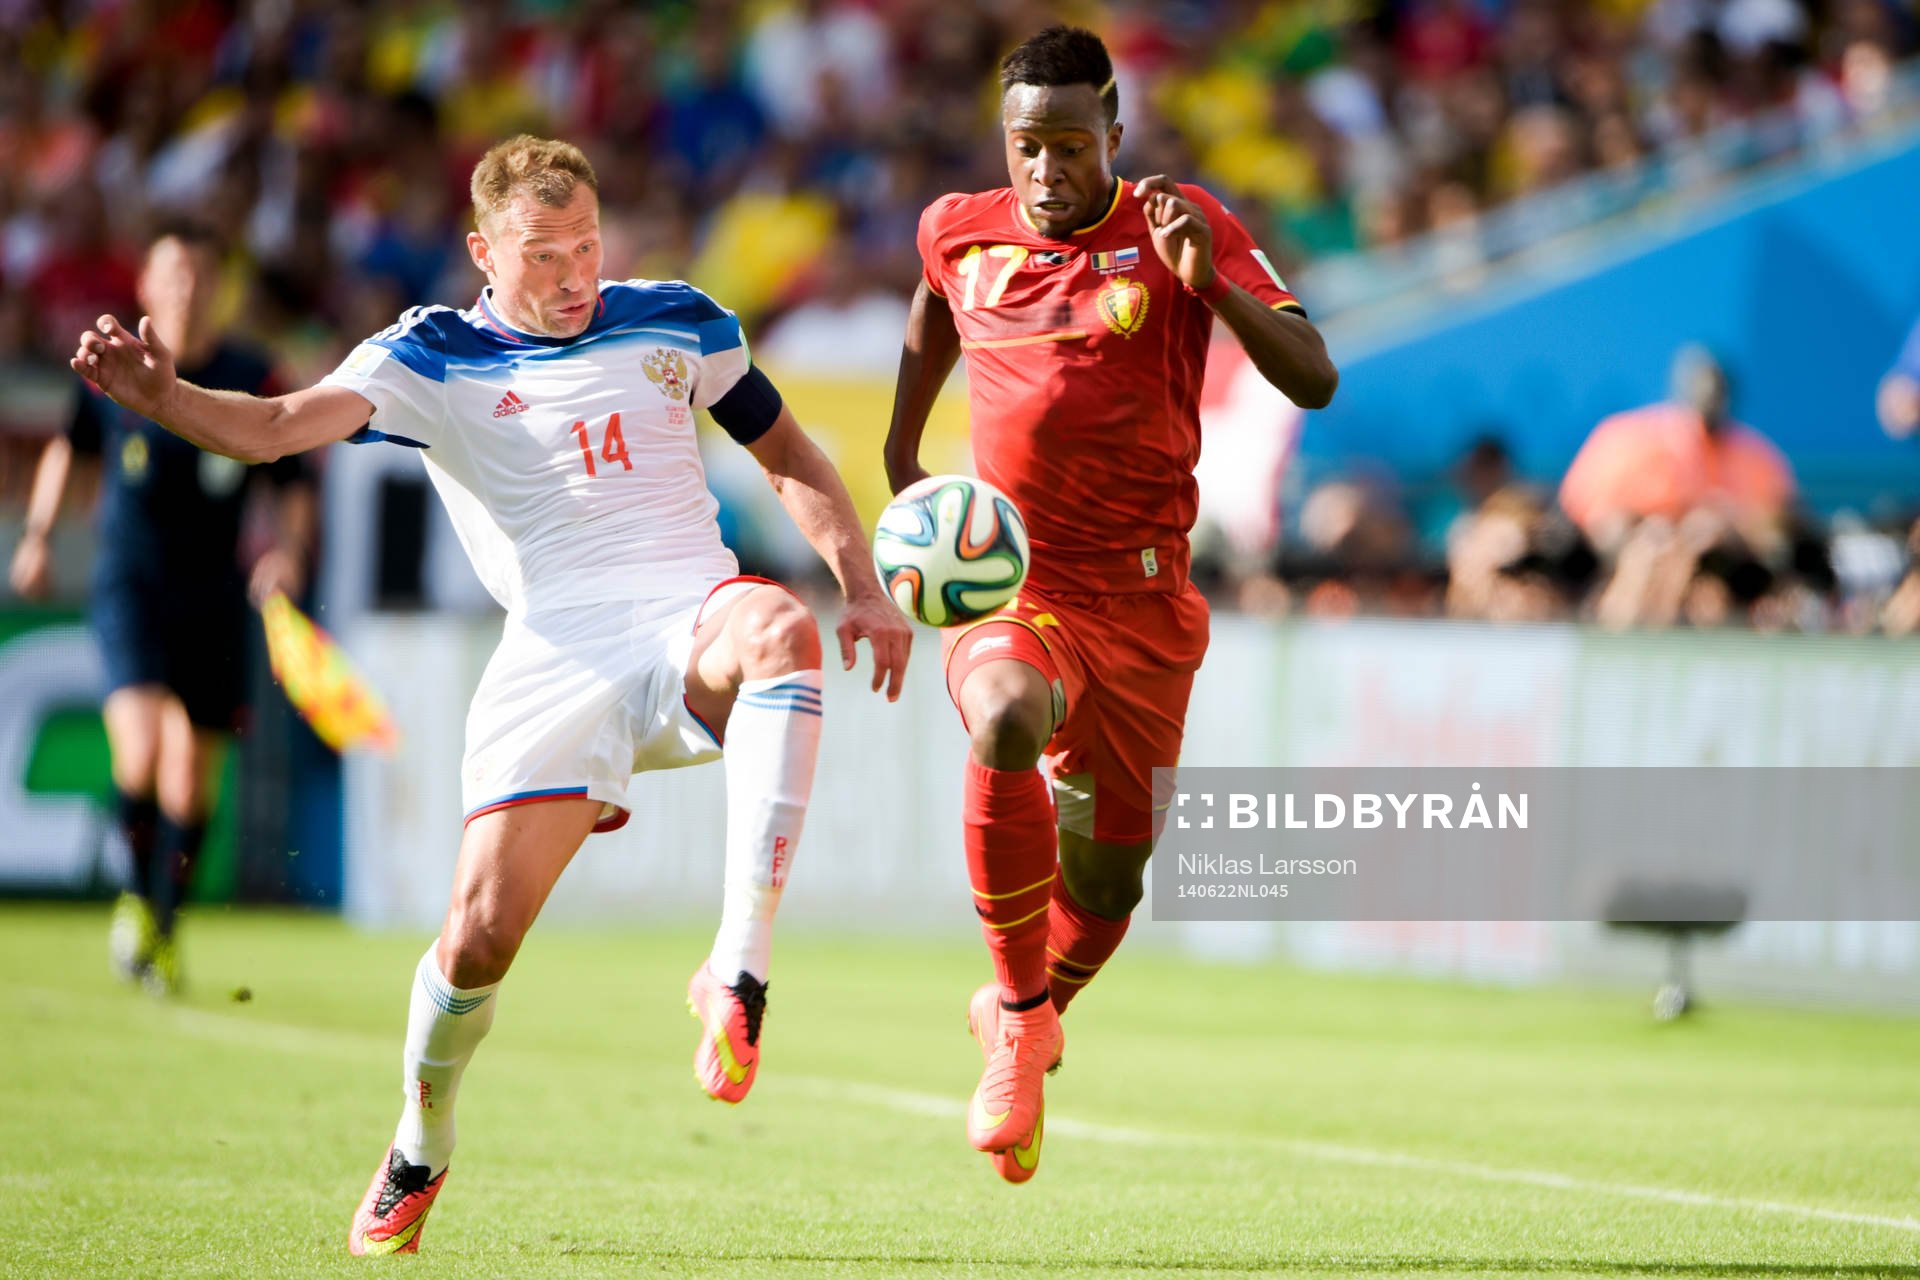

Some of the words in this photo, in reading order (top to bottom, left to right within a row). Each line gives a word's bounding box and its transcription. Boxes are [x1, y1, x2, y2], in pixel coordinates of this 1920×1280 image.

[957, 244, 1029, 312] 17
[492, 403, 529, 418] adidas
[570, 412, 633, 478] 14
